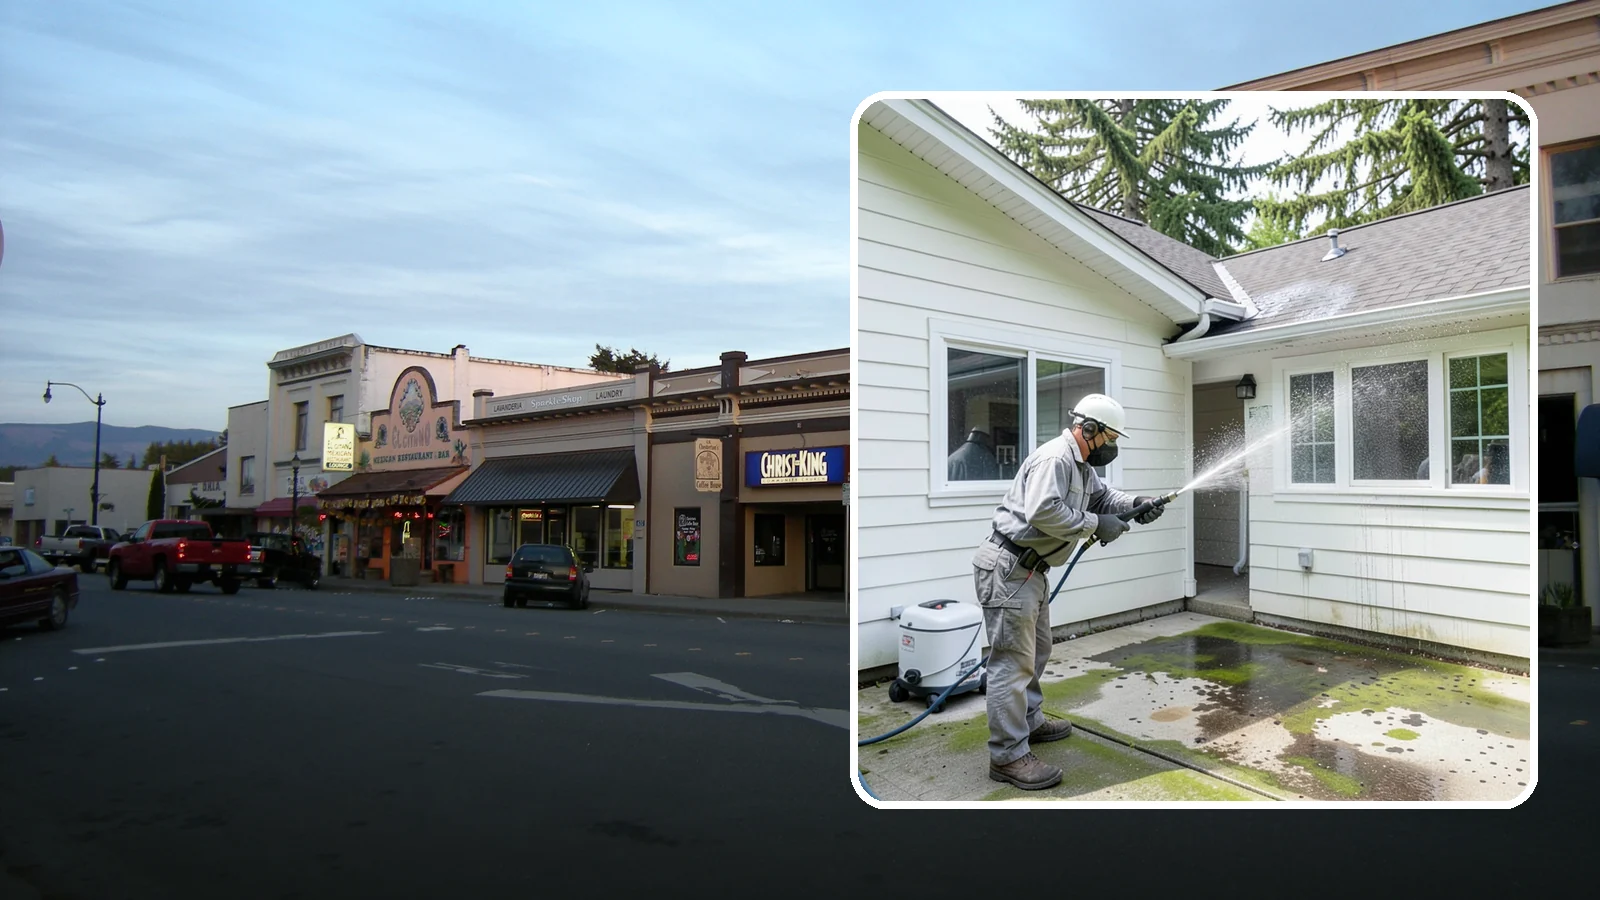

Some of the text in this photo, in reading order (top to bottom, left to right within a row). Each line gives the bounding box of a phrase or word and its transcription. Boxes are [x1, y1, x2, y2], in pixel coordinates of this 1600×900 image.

[493, 402, 523, 413] LAVANDERIA
[561, 394, 582, 404] Shop
[595, 389, 624, 400] LAUNDRY
[374, 450, 450, 464] MEXICAN RESTAURANT BAR
[761, 450, 827, 478] CHRIST KING
